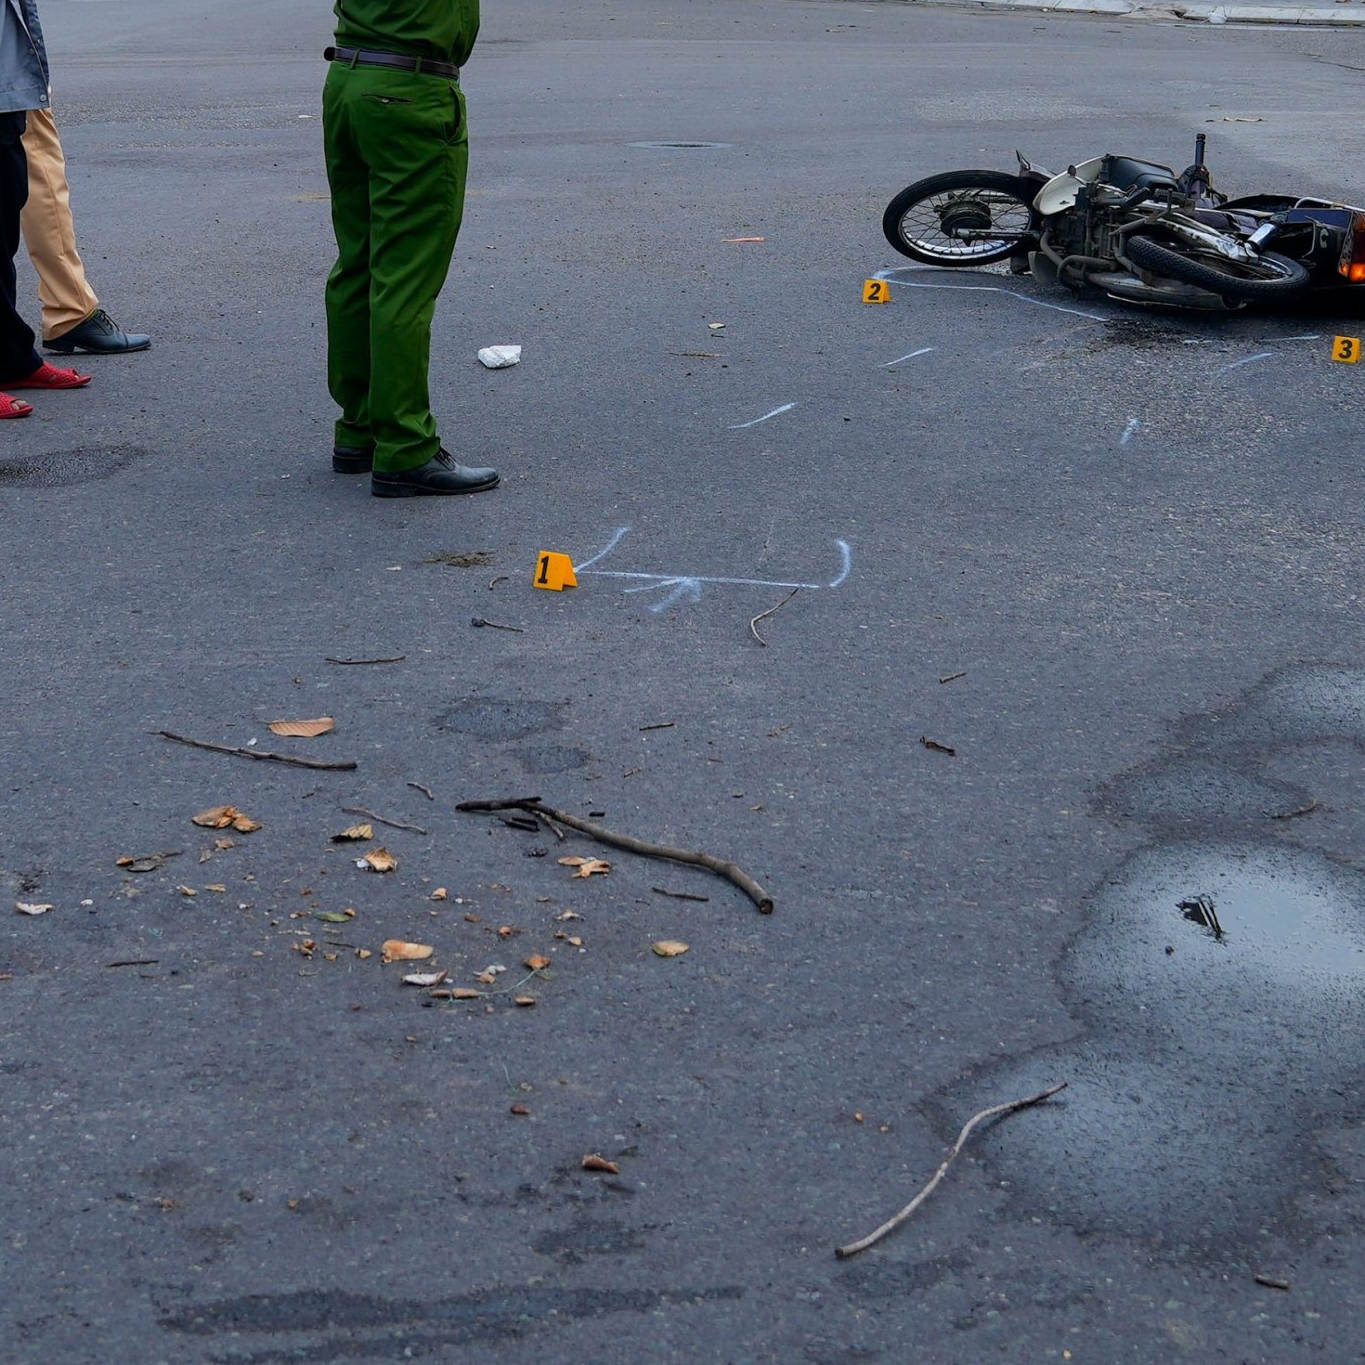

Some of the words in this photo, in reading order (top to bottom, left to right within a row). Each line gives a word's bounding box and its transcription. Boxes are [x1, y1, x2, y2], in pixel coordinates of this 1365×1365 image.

[867, 282, 881, 300] 2
[1338, 339, 1353, 359] 3
[537, 554, 550, 584] 1
